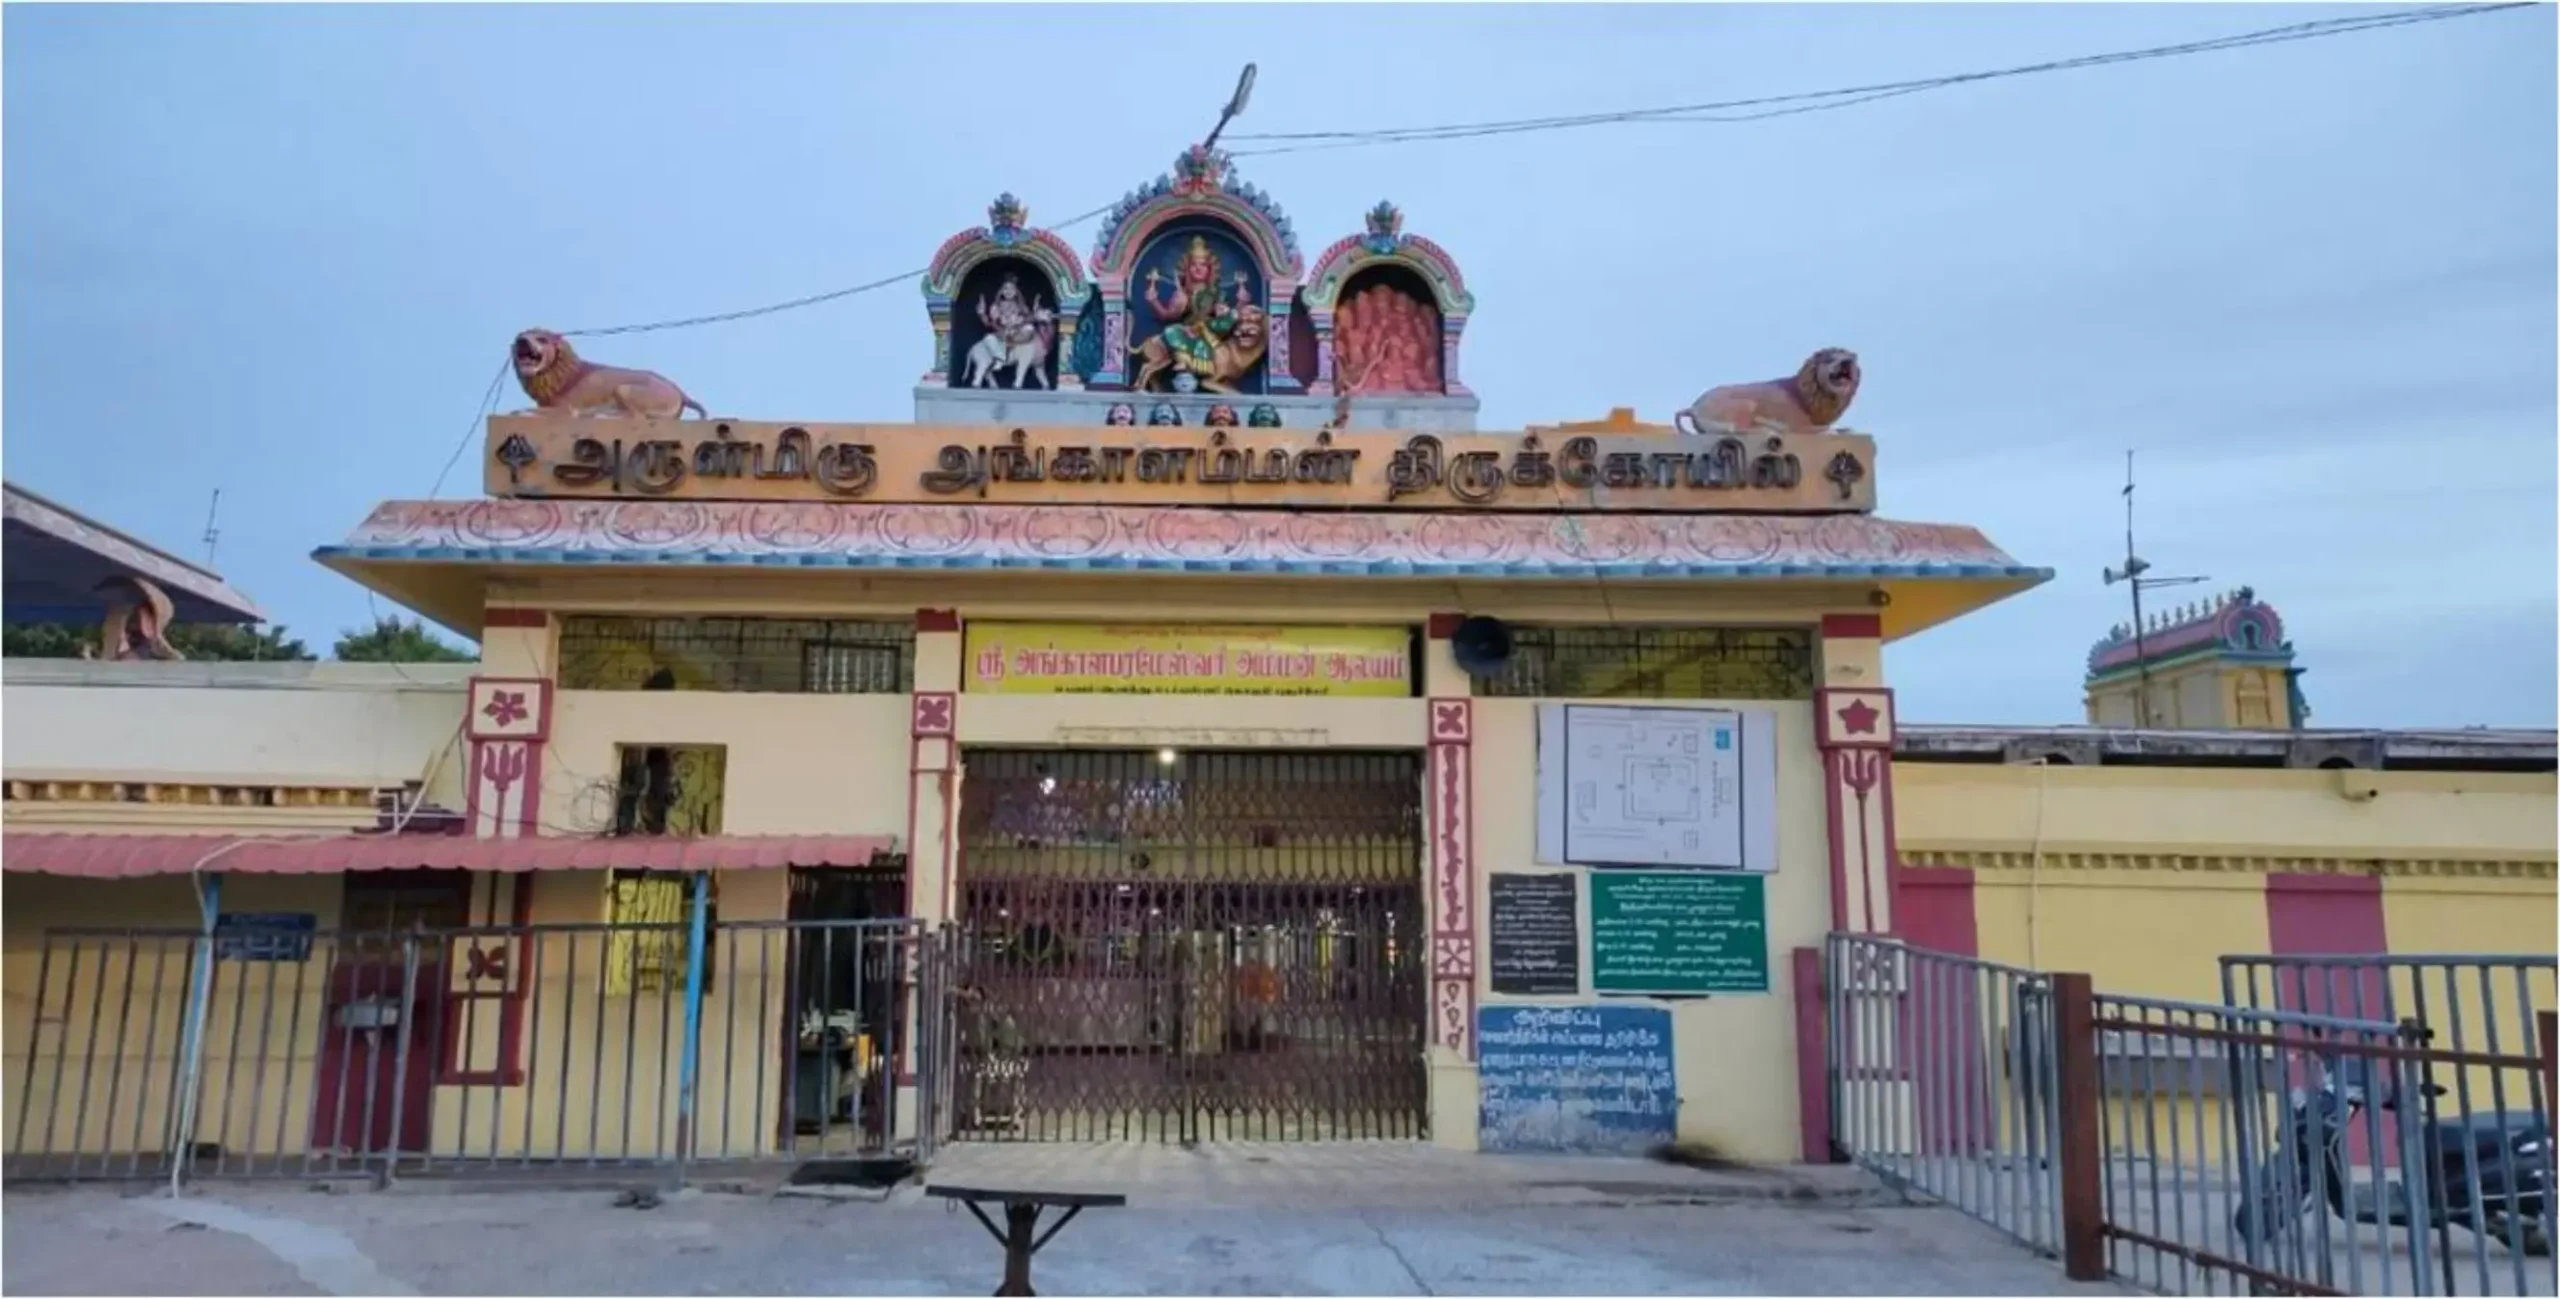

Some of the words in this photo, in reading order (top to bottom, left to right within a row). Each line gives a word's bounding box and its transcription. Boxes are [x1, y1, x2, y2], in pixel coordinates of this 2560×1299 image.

[553, 423, 878, 496] அருள்மிகு
[920, 427, 1360, 497] அங்காளம்மன்
[1386, 433, 1802, 502] திருக்கோயில்
[1235, 643, 1316, 678] அம்மன்
[1328, 646, 1406, 682] ஆலயம்
[1513, 1007, 1601, 1028] அறிவிப்பு
